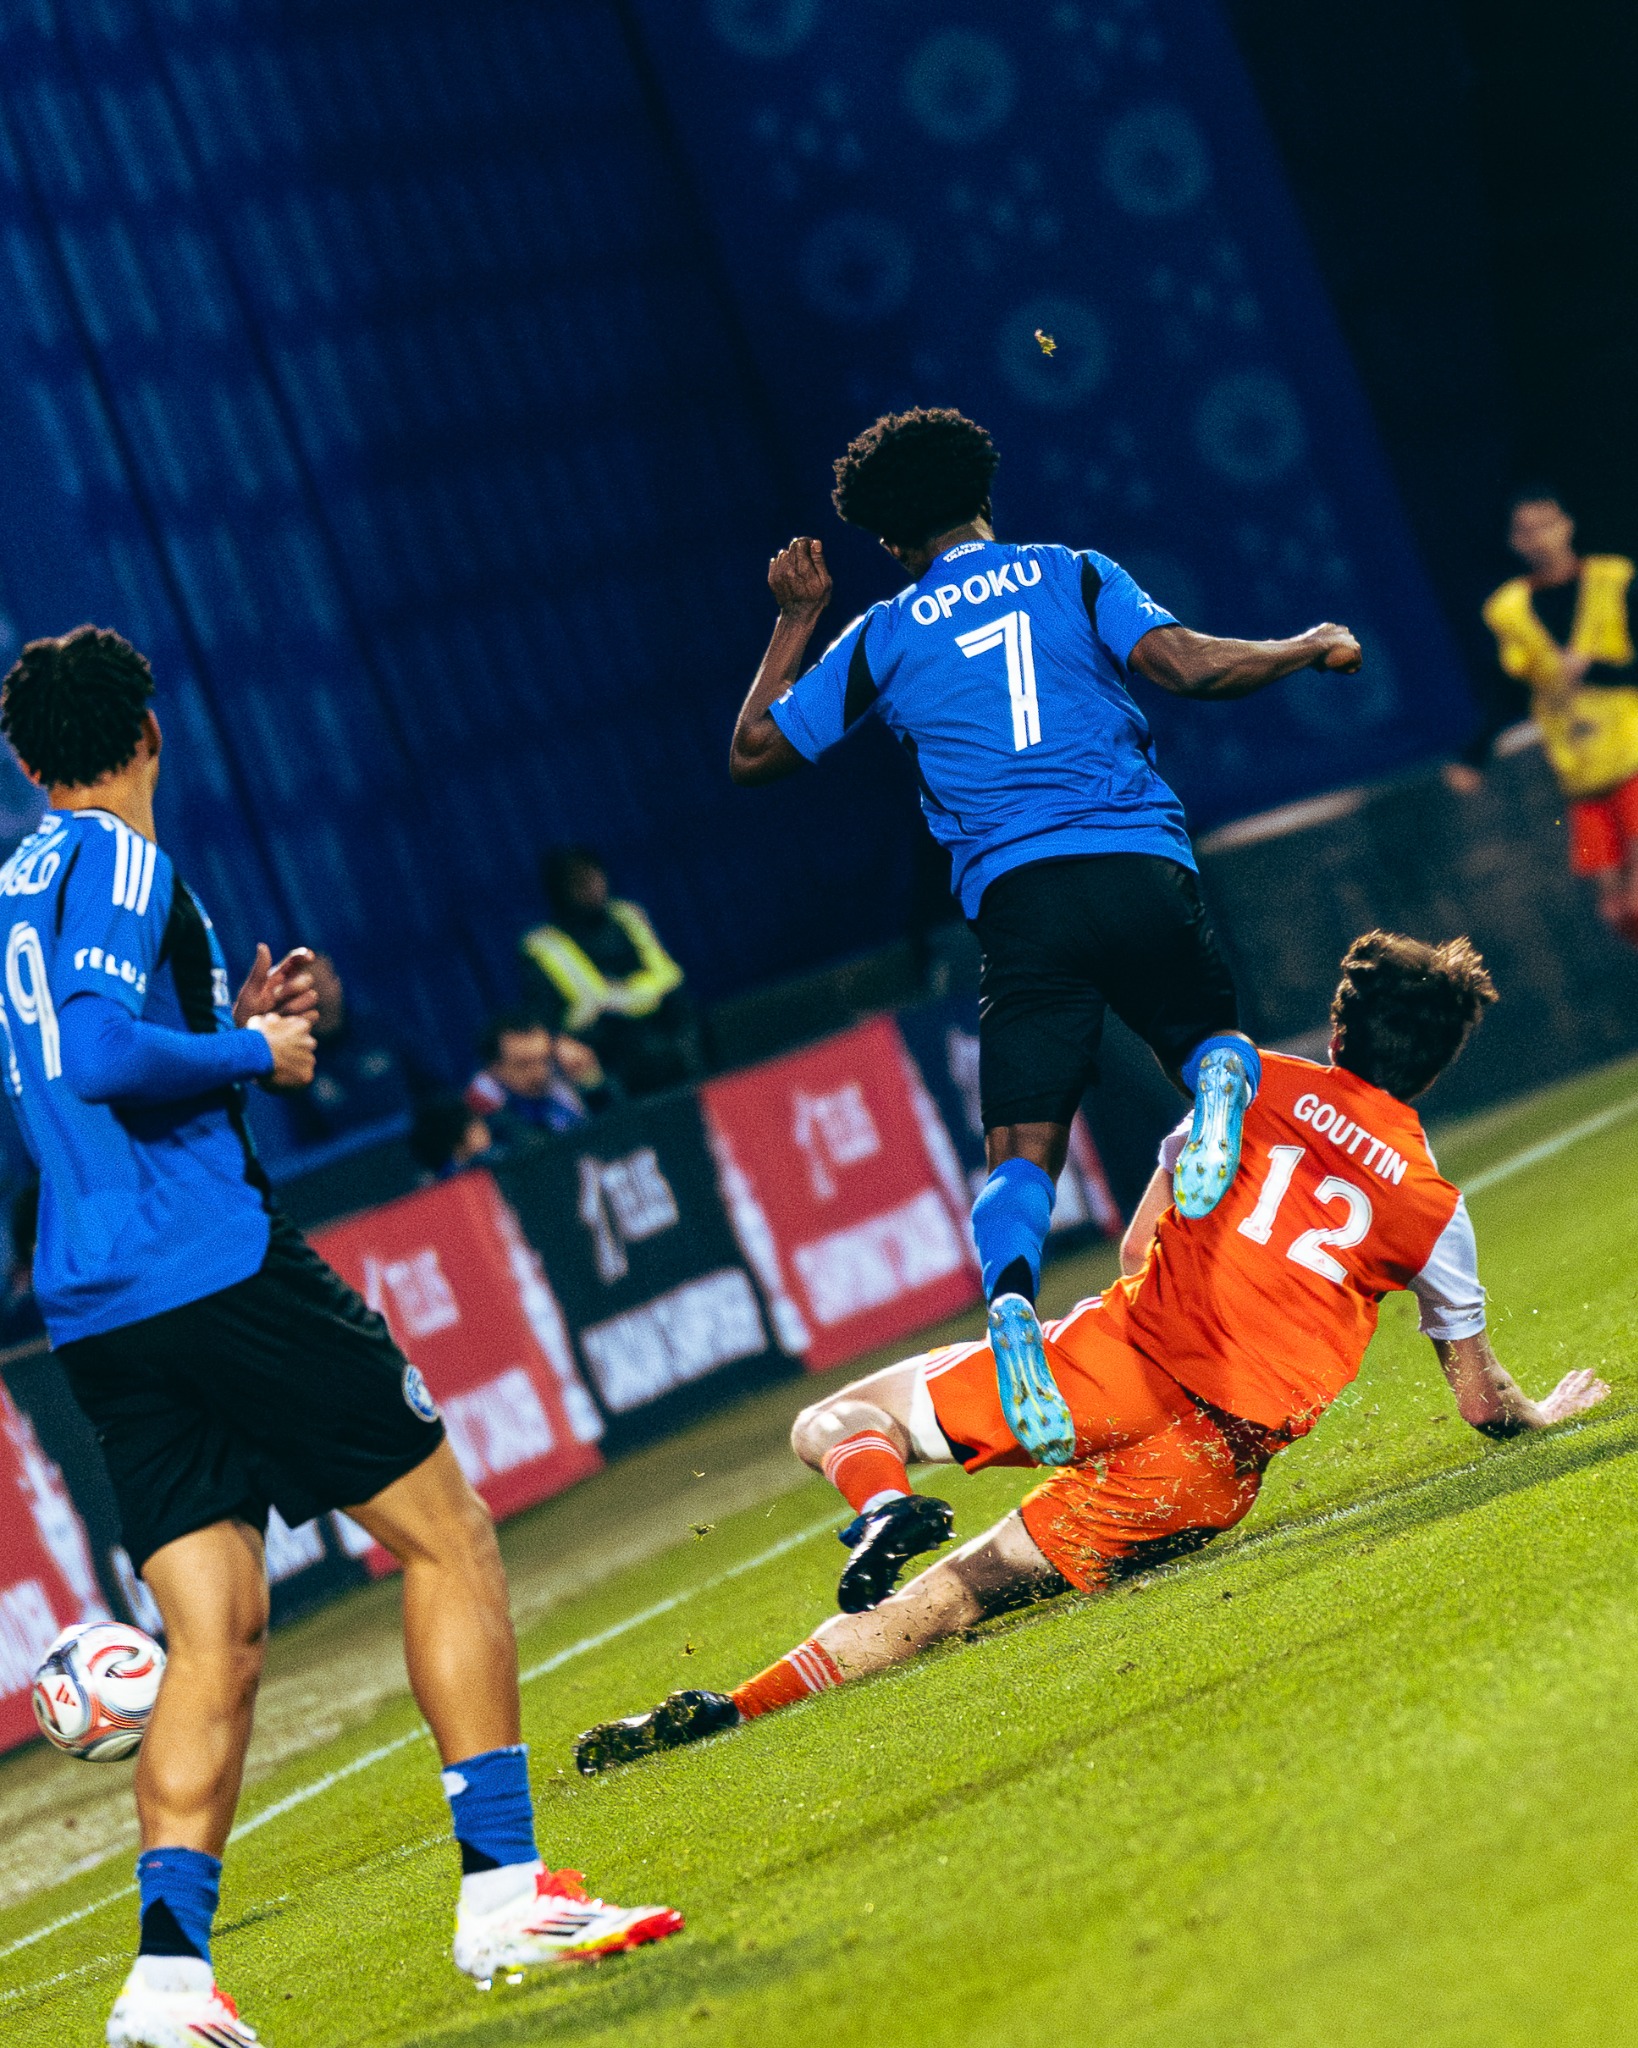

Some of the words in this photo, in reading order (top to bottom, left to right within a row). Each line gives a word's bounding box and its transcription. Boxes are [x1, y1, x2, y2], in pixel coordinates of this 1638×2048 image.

[911, 559, 1042, 626] OPOKU
[954, 610, 1042, 752] 7
[1293, 1093, 1409, 1186] GOUTTIN
[1237, 1144, 1373, 1285] 12
